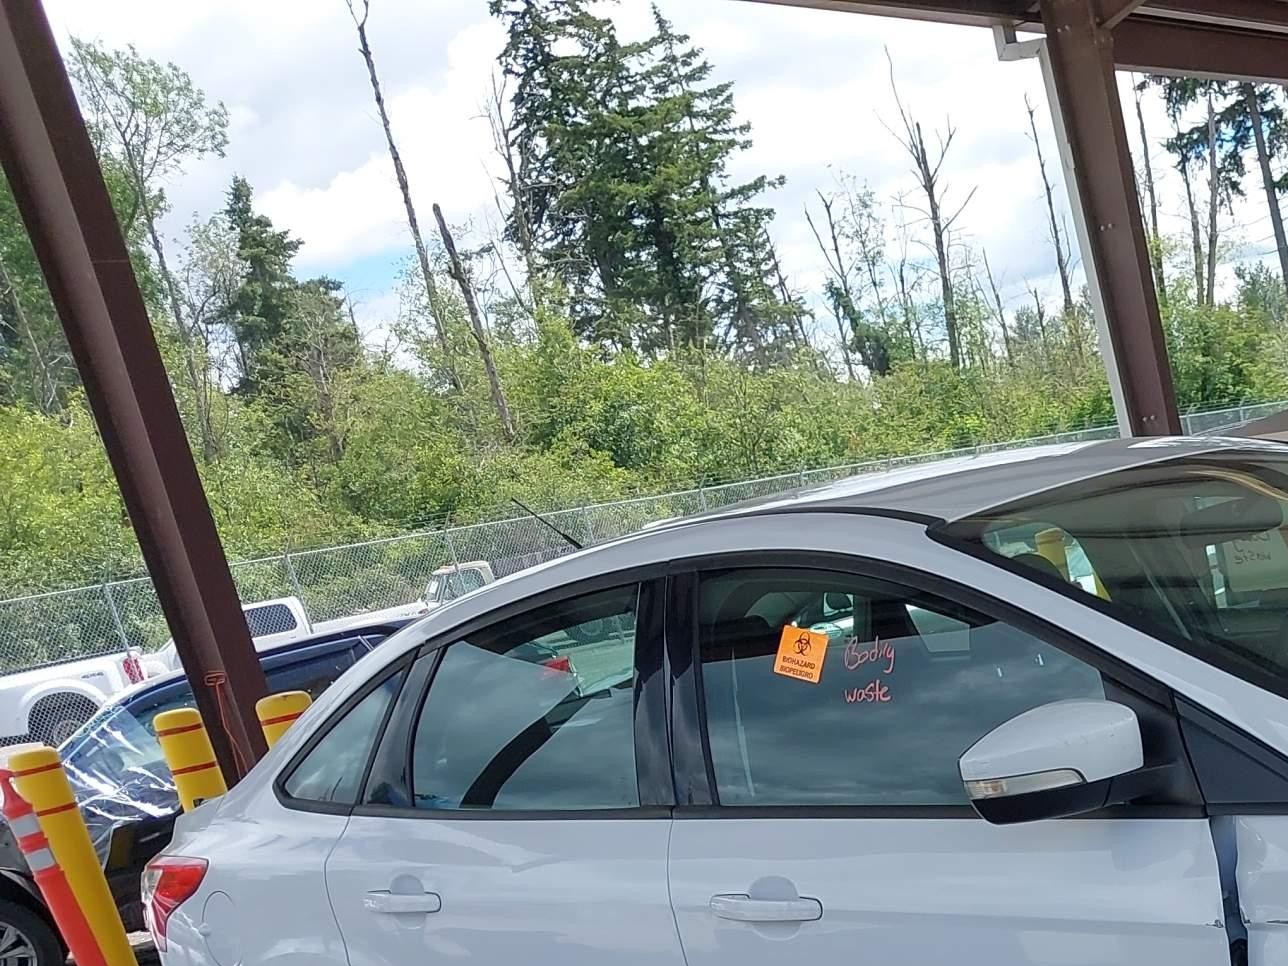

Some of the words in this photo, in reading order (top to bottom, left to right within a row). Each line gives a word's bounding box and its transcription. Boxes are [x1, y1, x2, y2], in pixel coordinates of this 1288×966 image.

[782, 655, 816, 670] BIOHAZARD
[779, 664, 814, 679] BIOPELIGRO
[844, 679, 891, 703] waste
